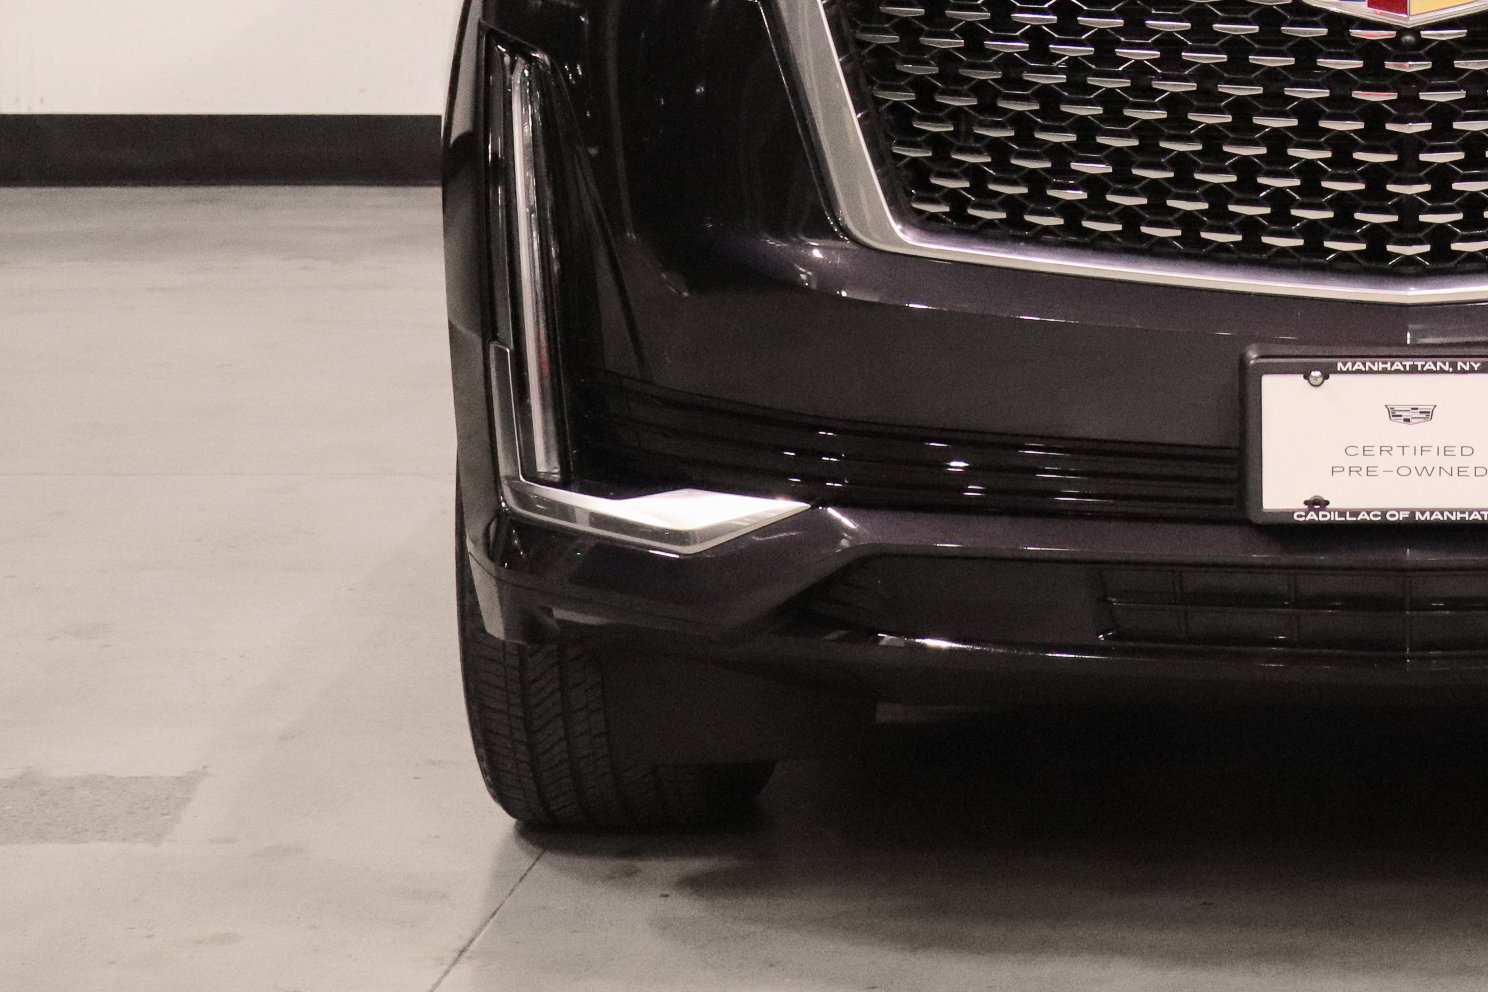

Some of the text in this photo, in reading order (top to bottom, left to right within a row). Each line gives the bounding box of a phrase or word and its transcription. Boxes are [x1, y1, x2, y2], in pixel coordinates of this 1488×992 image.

[1337, 361, 1481, 372] MANHATTAN, NY
[1344, 445, 1475, 457] CERTIFIED
[1331, 465, 1488, 477] PRE-OWNED
[1293, 511, 1382, 521] CADILLAC
[1386, 511, 1410, 521] OF
